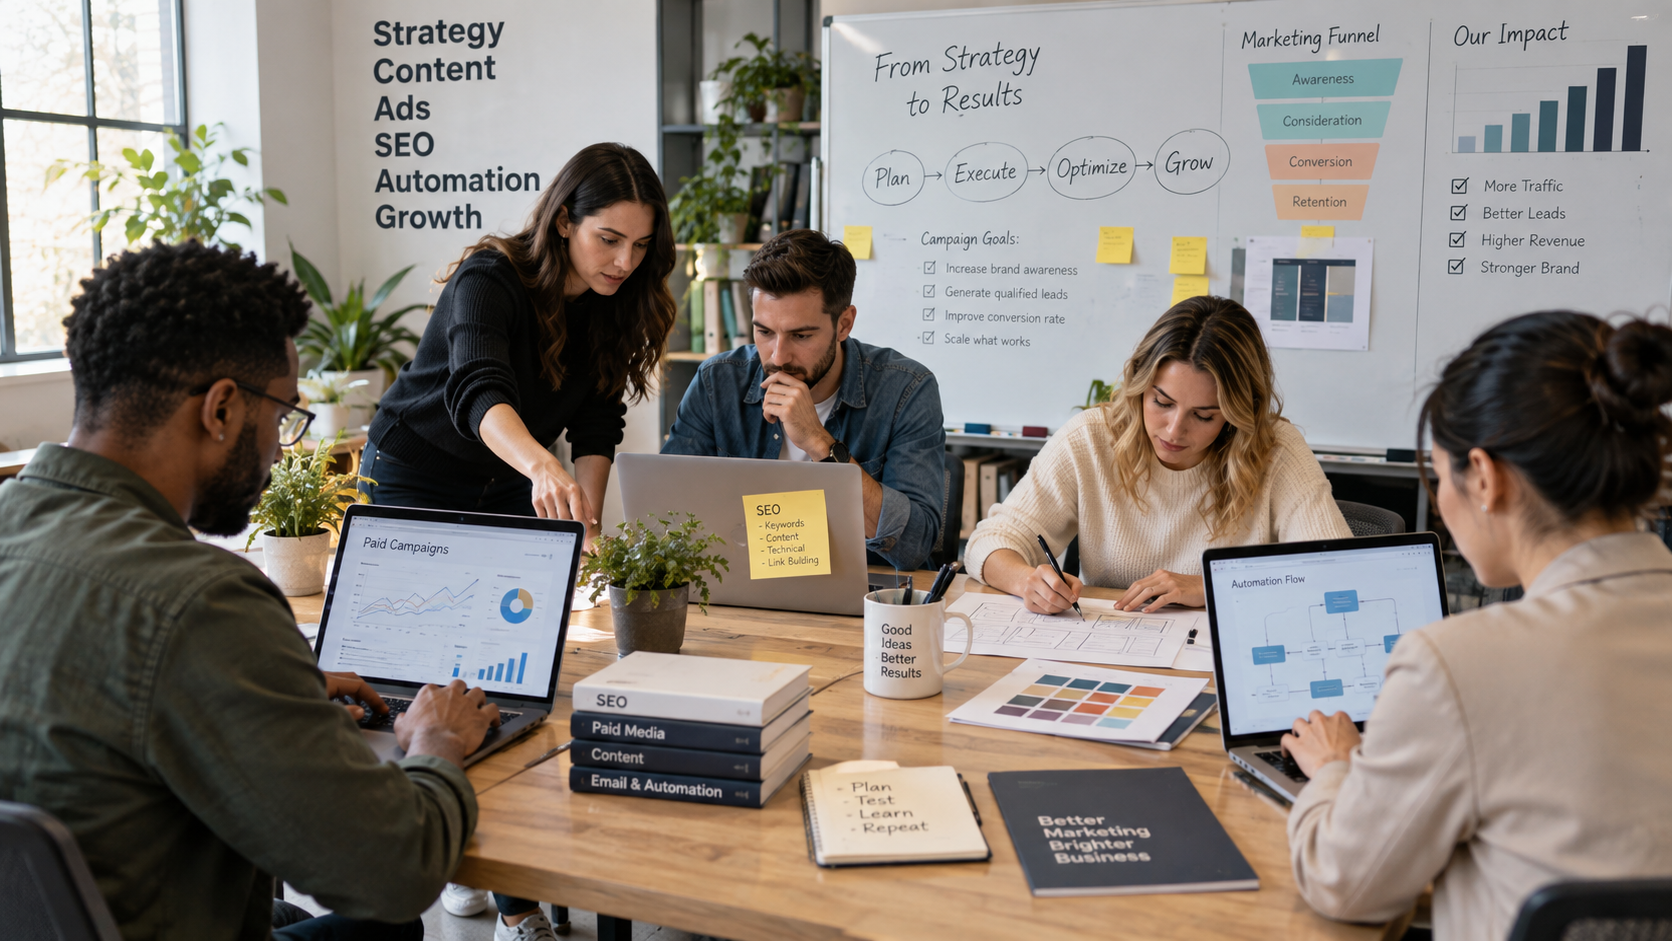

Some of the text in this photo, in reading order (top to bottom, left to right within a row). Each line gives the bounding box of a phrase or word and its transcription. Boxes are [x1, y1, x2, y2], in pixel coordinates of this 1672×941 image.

[374, 20, 504, 49] Strategy
[1241, 24, 1380, 53] Marketing Funnel
[1454, 20, 1569, 51] Our Impact
[875, 42, 1040, 82] From Strategy
[373, 56, 496, 84] Content
[1292, 73, 1354, 85] Awareness
[907, 81, 1023, 116] to Results
[374, 95, 430, 121] Ads
[1283, 114, 1362, 127] Consideration
[375, 131, 435, 157] SEO
[1165, 150, 1214, 175] Grow
[1289, 155, 1352, 168] Conversion
[875, 167, 910, 188] Plan
[954, 161, 1017, 184] Execute
[1057, 157, 1127, 185] Optimize
[375, 166, 541, 193] Automation
[1484, 179, 1564, 193] More Traffic
[1292, 195, 1347, 208] Retention
[375, 203, 482, 229] Growth
[1483, 206, 1566, 220] Better Leads
[921, 230, 1020, 251] Campaign Goals:
[1481, 233, 1586, 250] Higher Revenue
[946, 263, 1078, 276] Increase brand awareness
[1480, 261, 1580, 277] Stronger Brand
[945, 286, 1069, 301] Generate qualified leads
[945, 310, 1066, 325] Improve conversion rate
[944, 333, 1031, 347] Scale what works
[756, 503, 781, 516] SEO
[765, 518, 805, 531] Keywords
[766, 532, 799, 543] Content
[363, 536, 449, 557] Paid Campaigns
[767, 544, 806, 555] Technical
[768, 557, 785, 567] Link
[1231, 574, 1306, 589] Automation Flow
[881, 624, 912, 636] Good
[881, 637, 912, 650] Ideas
[881, 652, 917, 665] Better
[880, 666, 922, 679] Results
[596, 693, 628, 708] SEO
[592, 721, 666, 740] Paid Media
[591, 747, 645, 765] Content
[591, 774, 627, 790] Email
[630, 778, 641, 790] &
[644, 778, 723, 799] Automation
[851, 781, 892, 793] Plan
[854, 795, 896, 806] Test
[859, 809, 914, 820] Learn
[1037, 815, 1105, 827] Better
[863, 821, 929, 836] Repeat
[1043, 825, 1151, 839] Marketing
[1049, 839, 1134, 853] Brighter
[1054, 852, 1151, 864] Business
